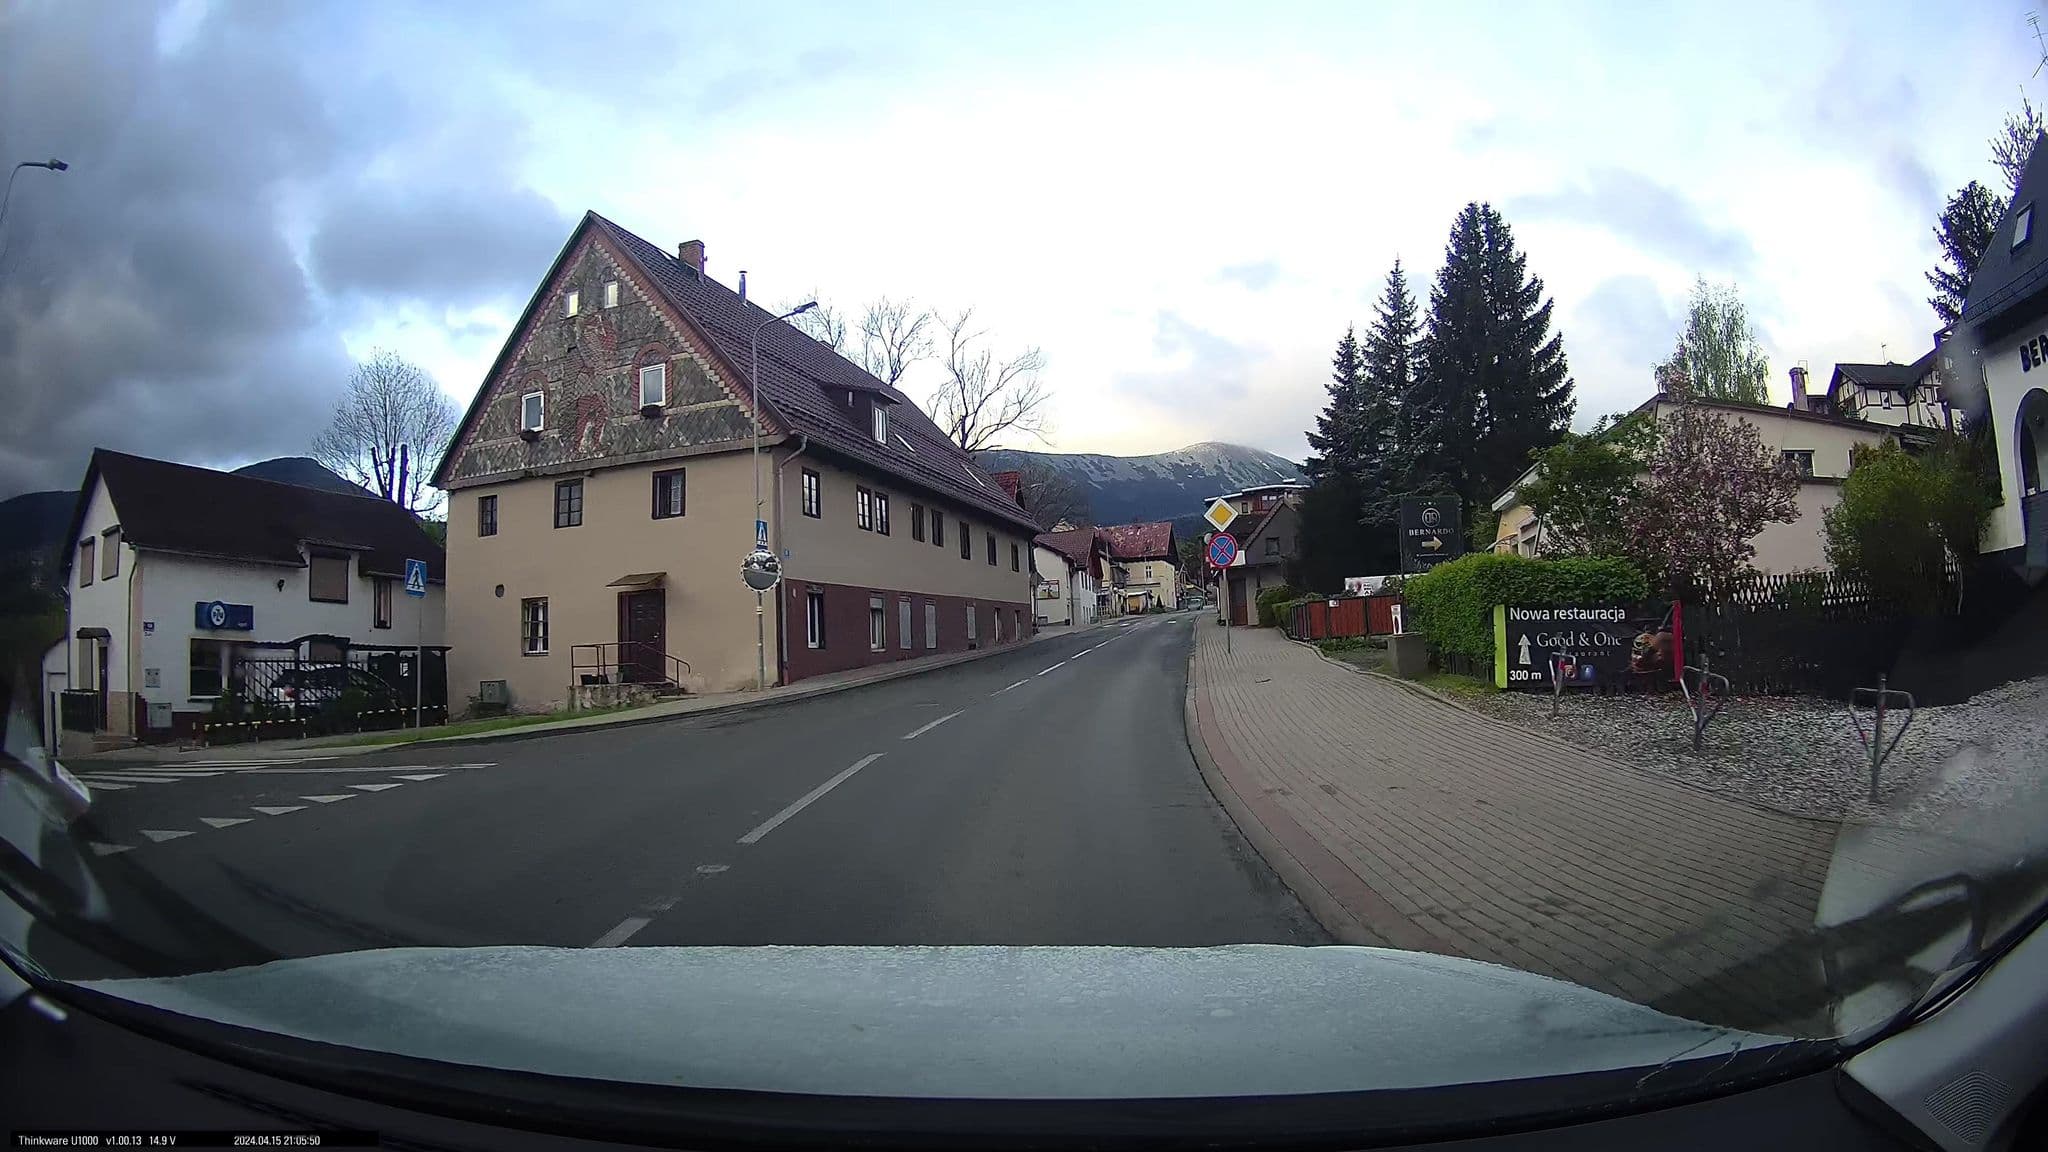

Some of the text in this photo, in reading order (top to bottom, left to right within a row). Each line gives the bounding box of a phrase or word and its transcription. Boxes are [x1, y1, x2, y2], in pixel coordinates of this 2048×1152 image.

[1409, 528, 1454, 537] BERNARDO
[1510, 606, 1625, 622] Nowa restauracja
[1537, 631, 1574, 647] Good
[1579, 632, 1591, 646] &
[1509, 670, 1542, 681] 300 m
